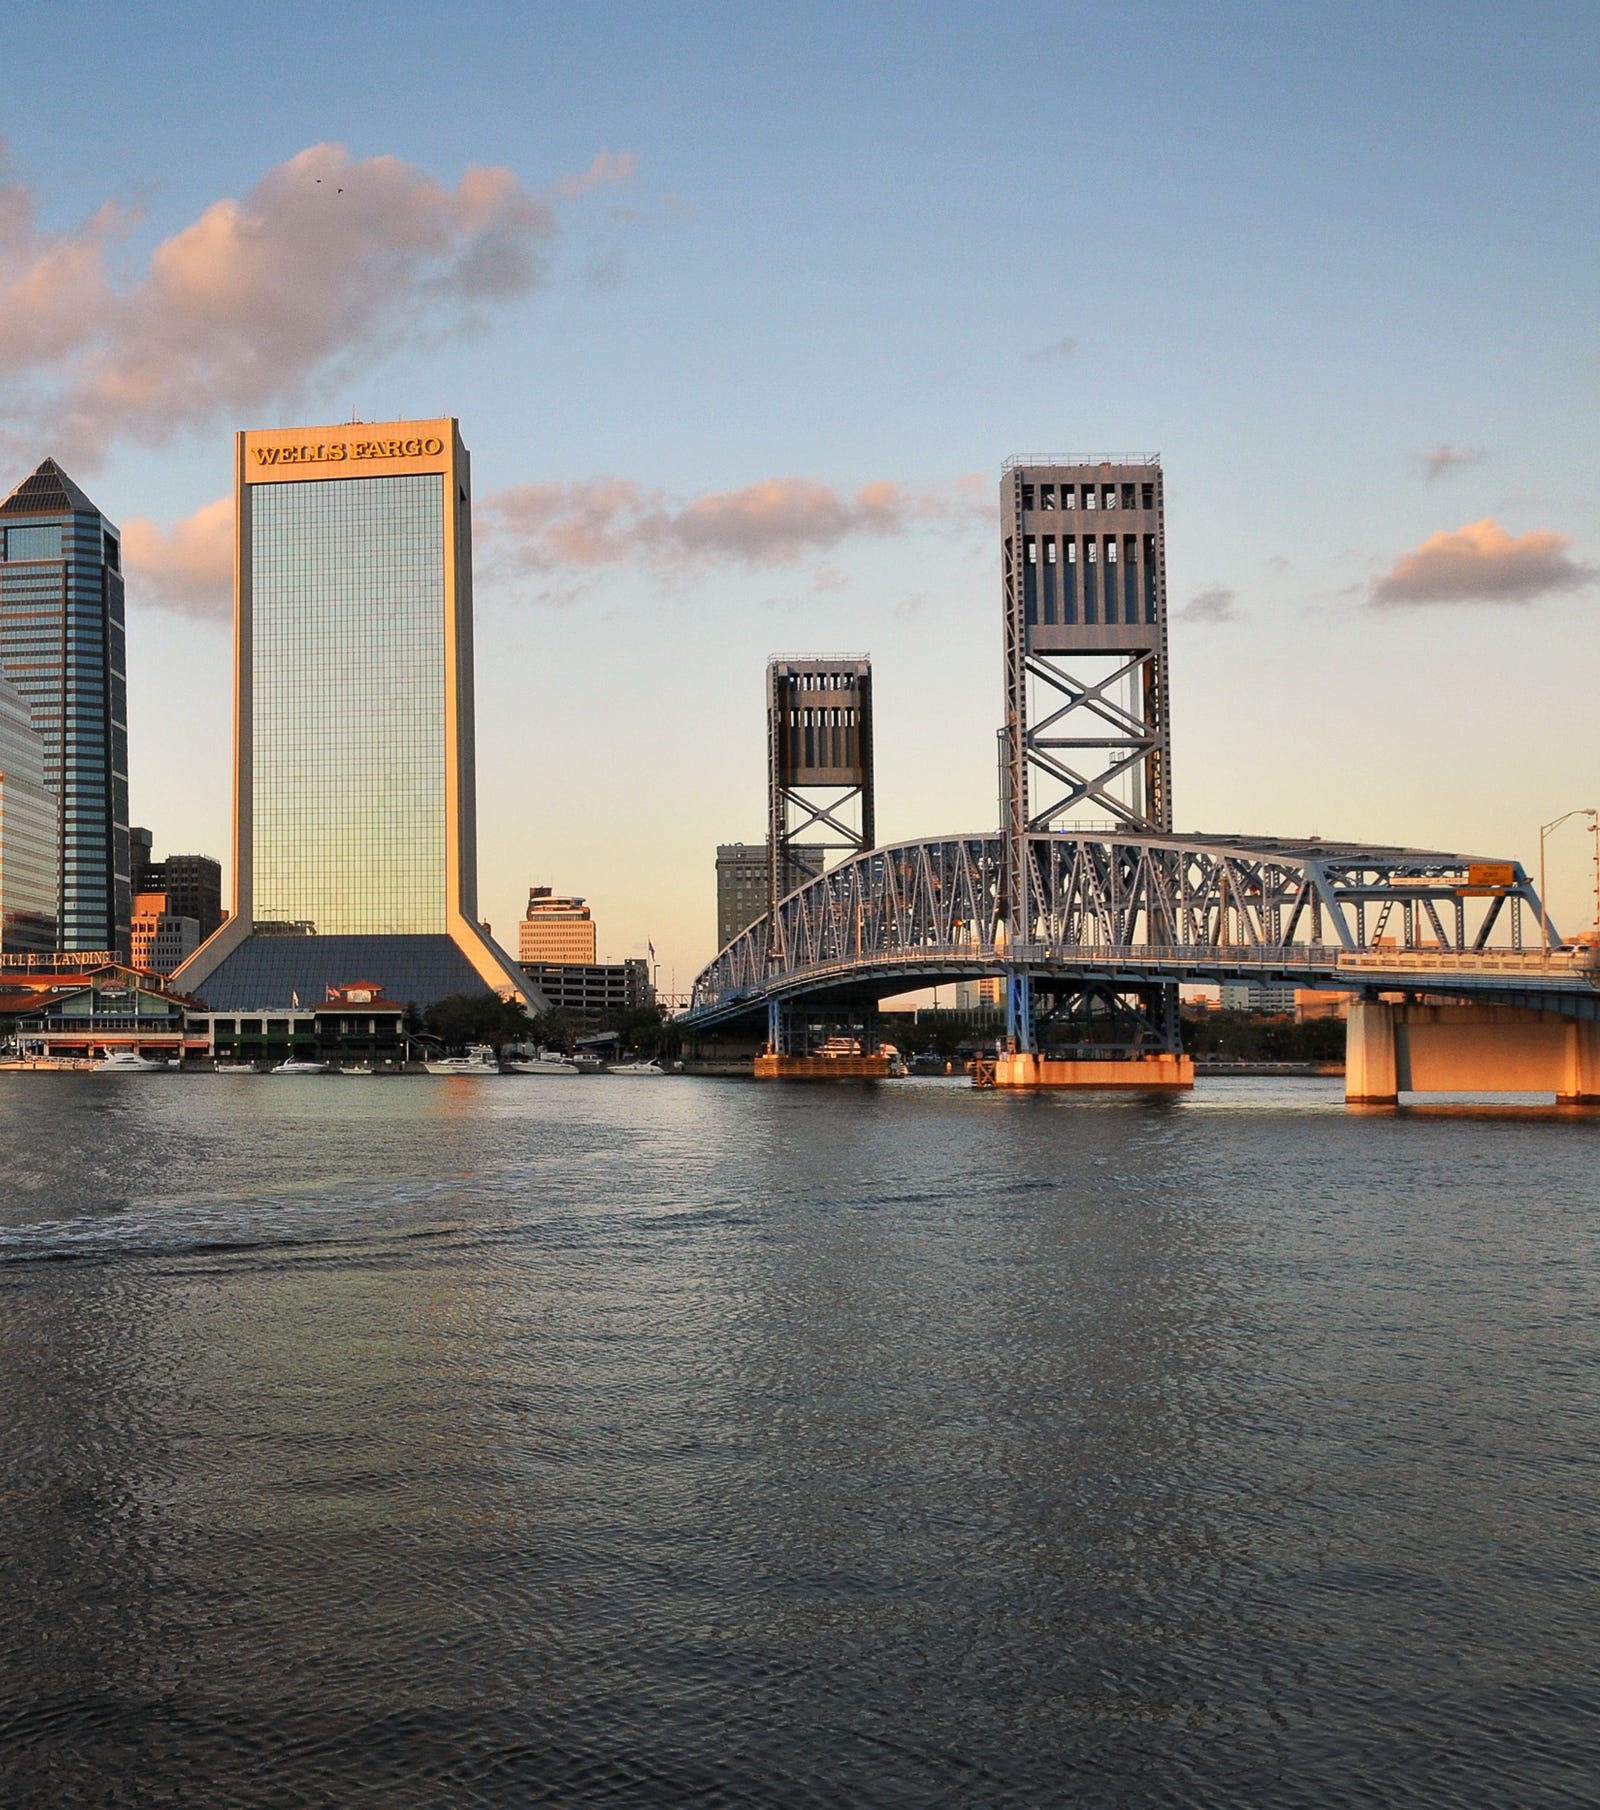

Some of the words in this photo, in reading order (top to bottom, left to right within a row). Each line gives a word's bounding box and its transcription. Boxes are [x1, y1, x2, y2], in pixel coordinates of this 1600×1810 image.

[253, 442, 347, 466] WELLS
[350, 436, 445, 459] FARGO
[53, 952, 109, 965] LANDING
